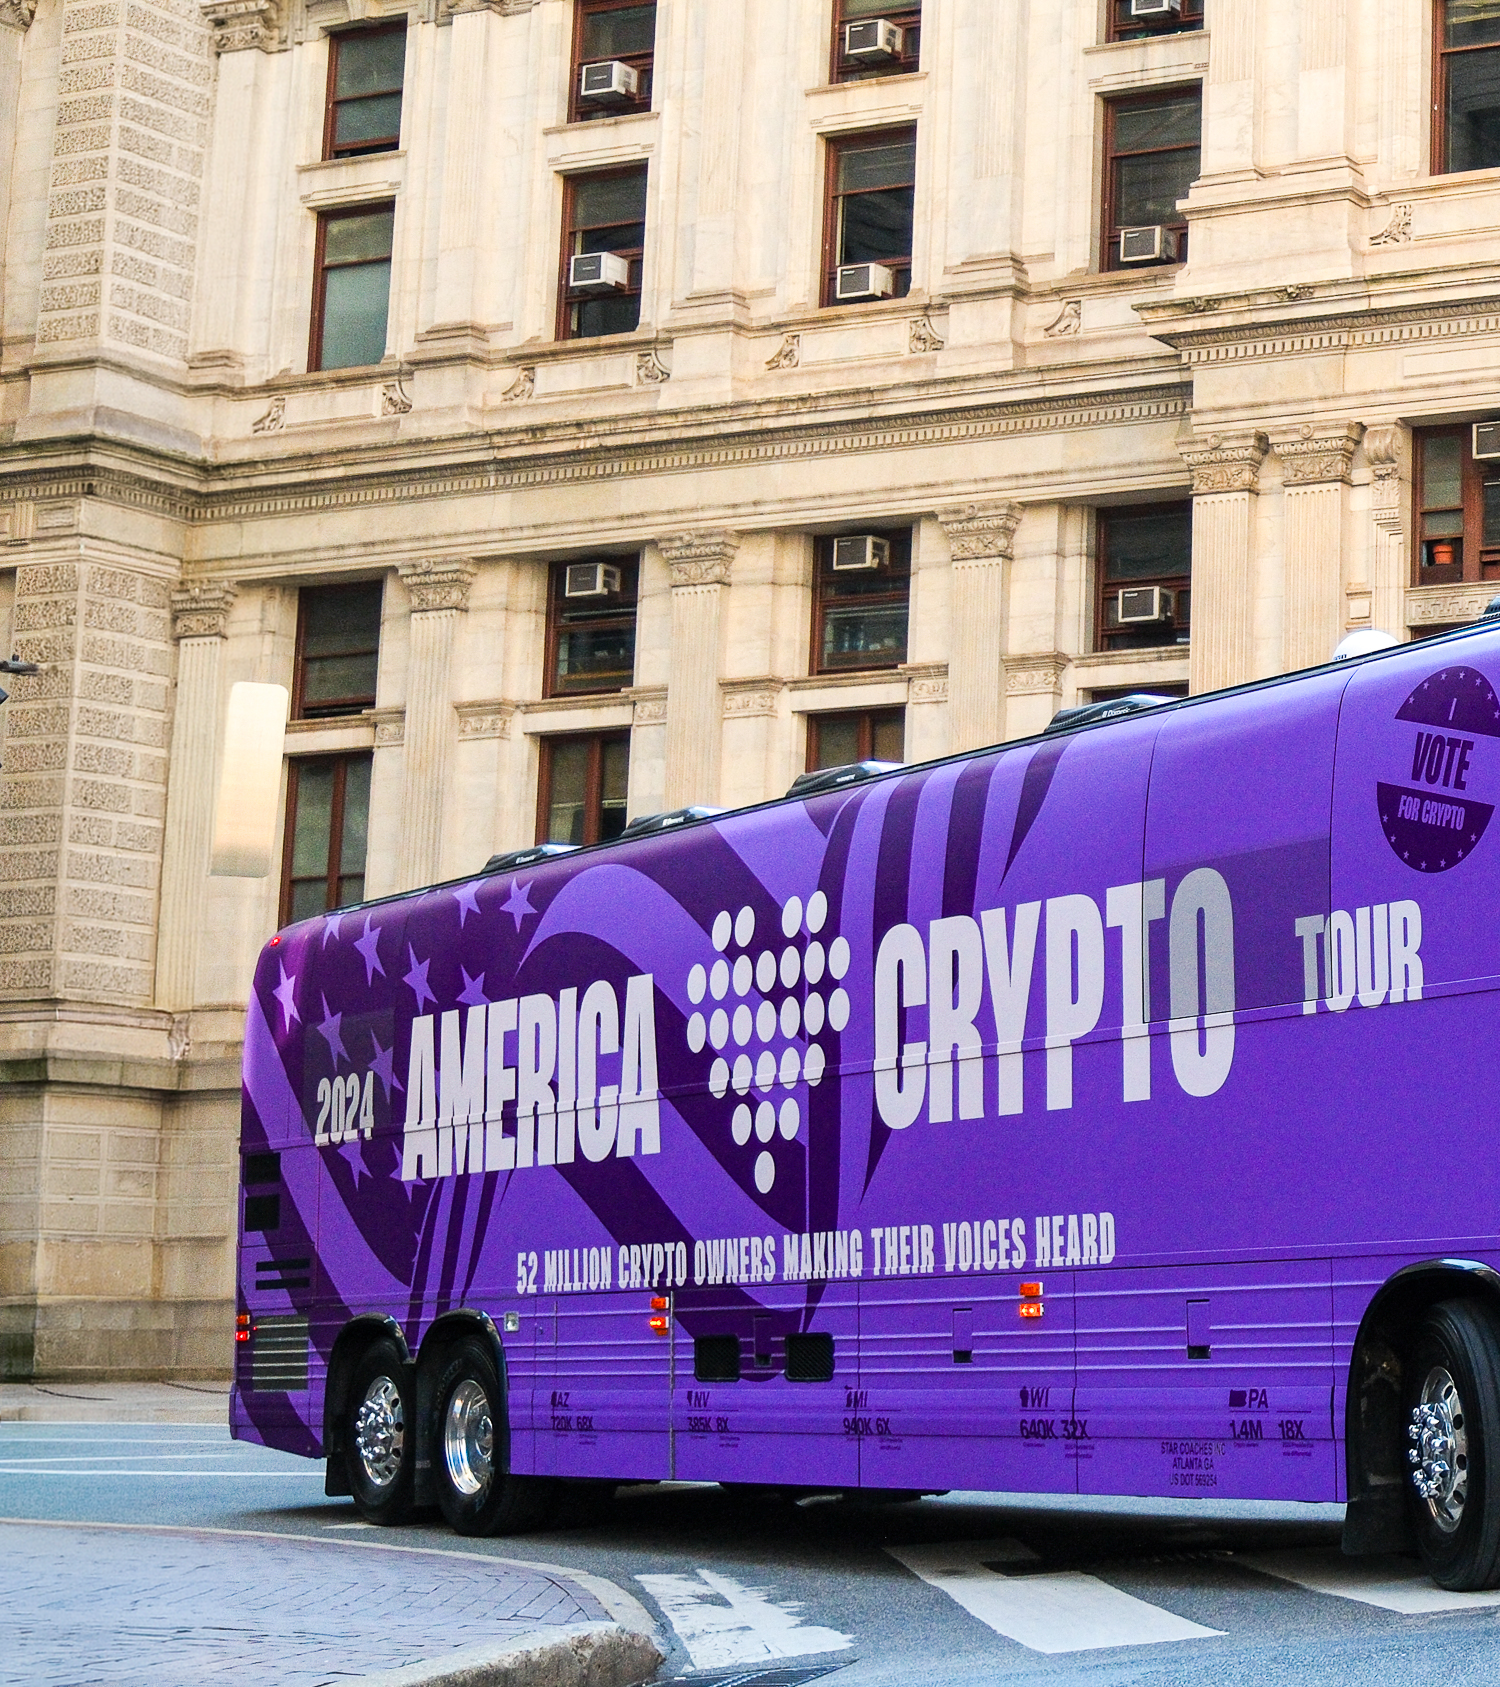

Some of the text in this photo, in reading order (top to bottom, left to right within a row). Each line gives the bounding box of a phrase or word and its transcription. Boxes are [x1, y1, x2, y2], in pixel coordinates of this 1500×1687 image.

[1448, 697, 1457, 721] I
[1411, 731, 1475, 791] VOTE
[1397, 794, 1466, 831] FOR CRYPTO
[314, 867, 1424, 1182] 2024 AMERICA CRYPTO TOUR
[516, 1211, 1116, 1294] 52 MILLION CRYPTO OWNERS MAKING THEIR VOICES HEARD
[694, 1391, 710, 1408] NV
[1030, 1387, 1050, 1408] WI
[1248, 1388, 1269, 1409] PA
[716, 1416, 729, 1432] 8X
[876, 1417, 892, 1435] 6X
[1020, 1418, 1058, 1440] 640K
[1229, 1419, 1305, 1440] 1.4M 18X
[1172, 1457, 1202, 1470] ATLANTA
